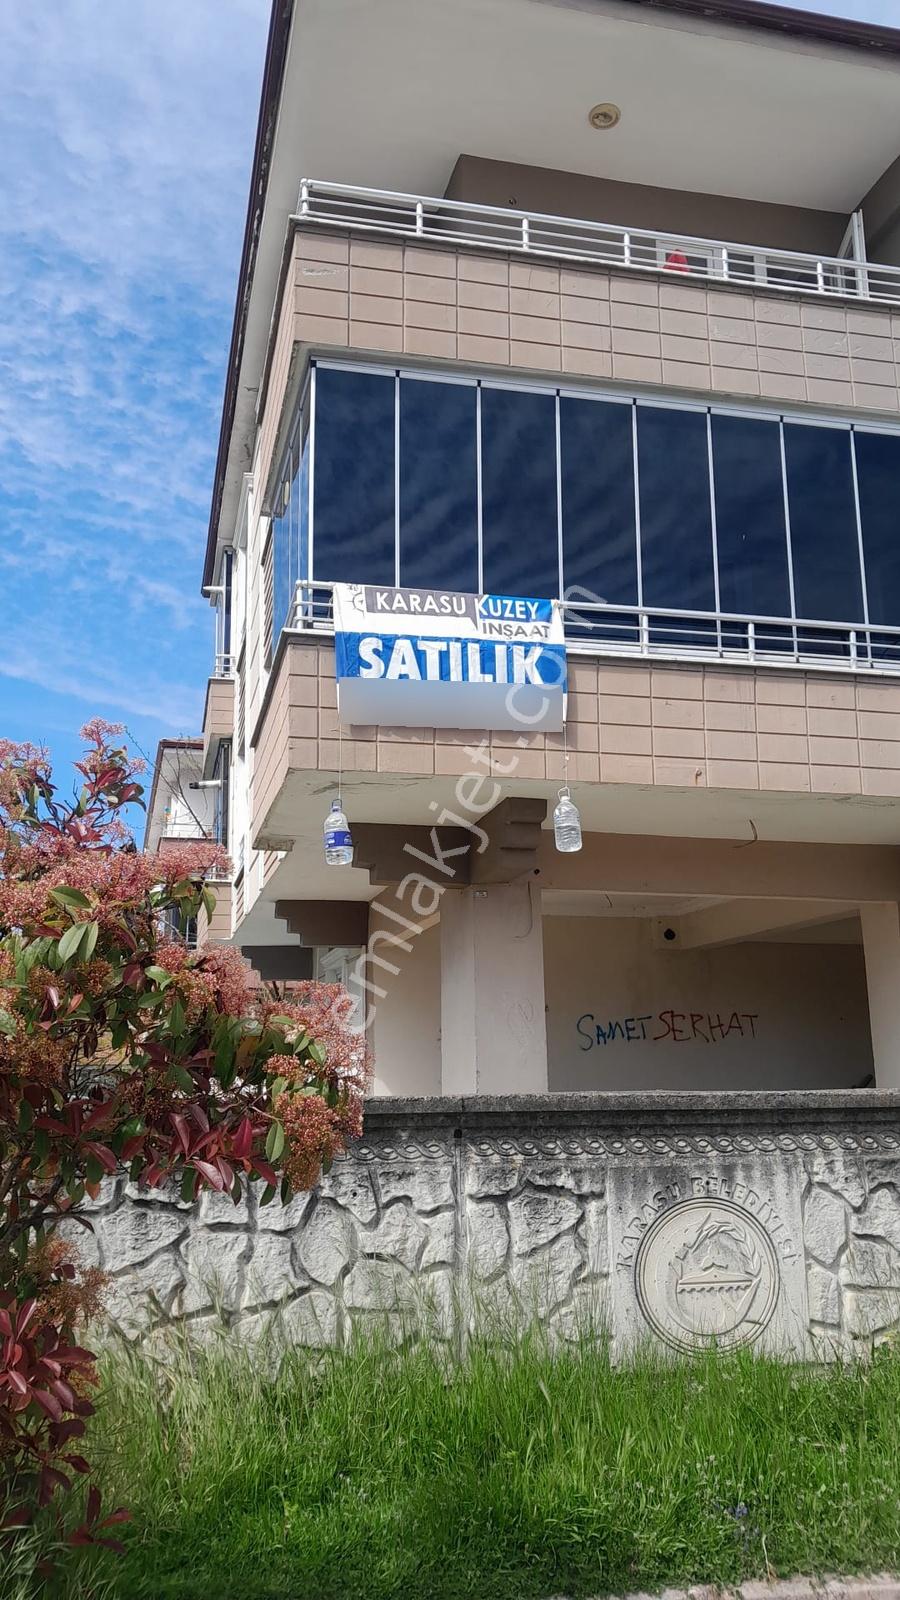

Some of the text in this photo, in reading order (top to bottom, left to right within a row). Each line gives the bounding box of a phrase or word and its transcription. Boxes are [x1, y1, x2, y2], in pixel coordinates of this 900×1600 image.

[376, 592, 539, 619] KARASU KUZEY
[482, 620, 550, 639] İNŞAAT
[358, 637, 544, 685] SATILIK
[653, 1010, 758, 1042] SERHAT
[616, 1182, 681, 1273] KARASU
